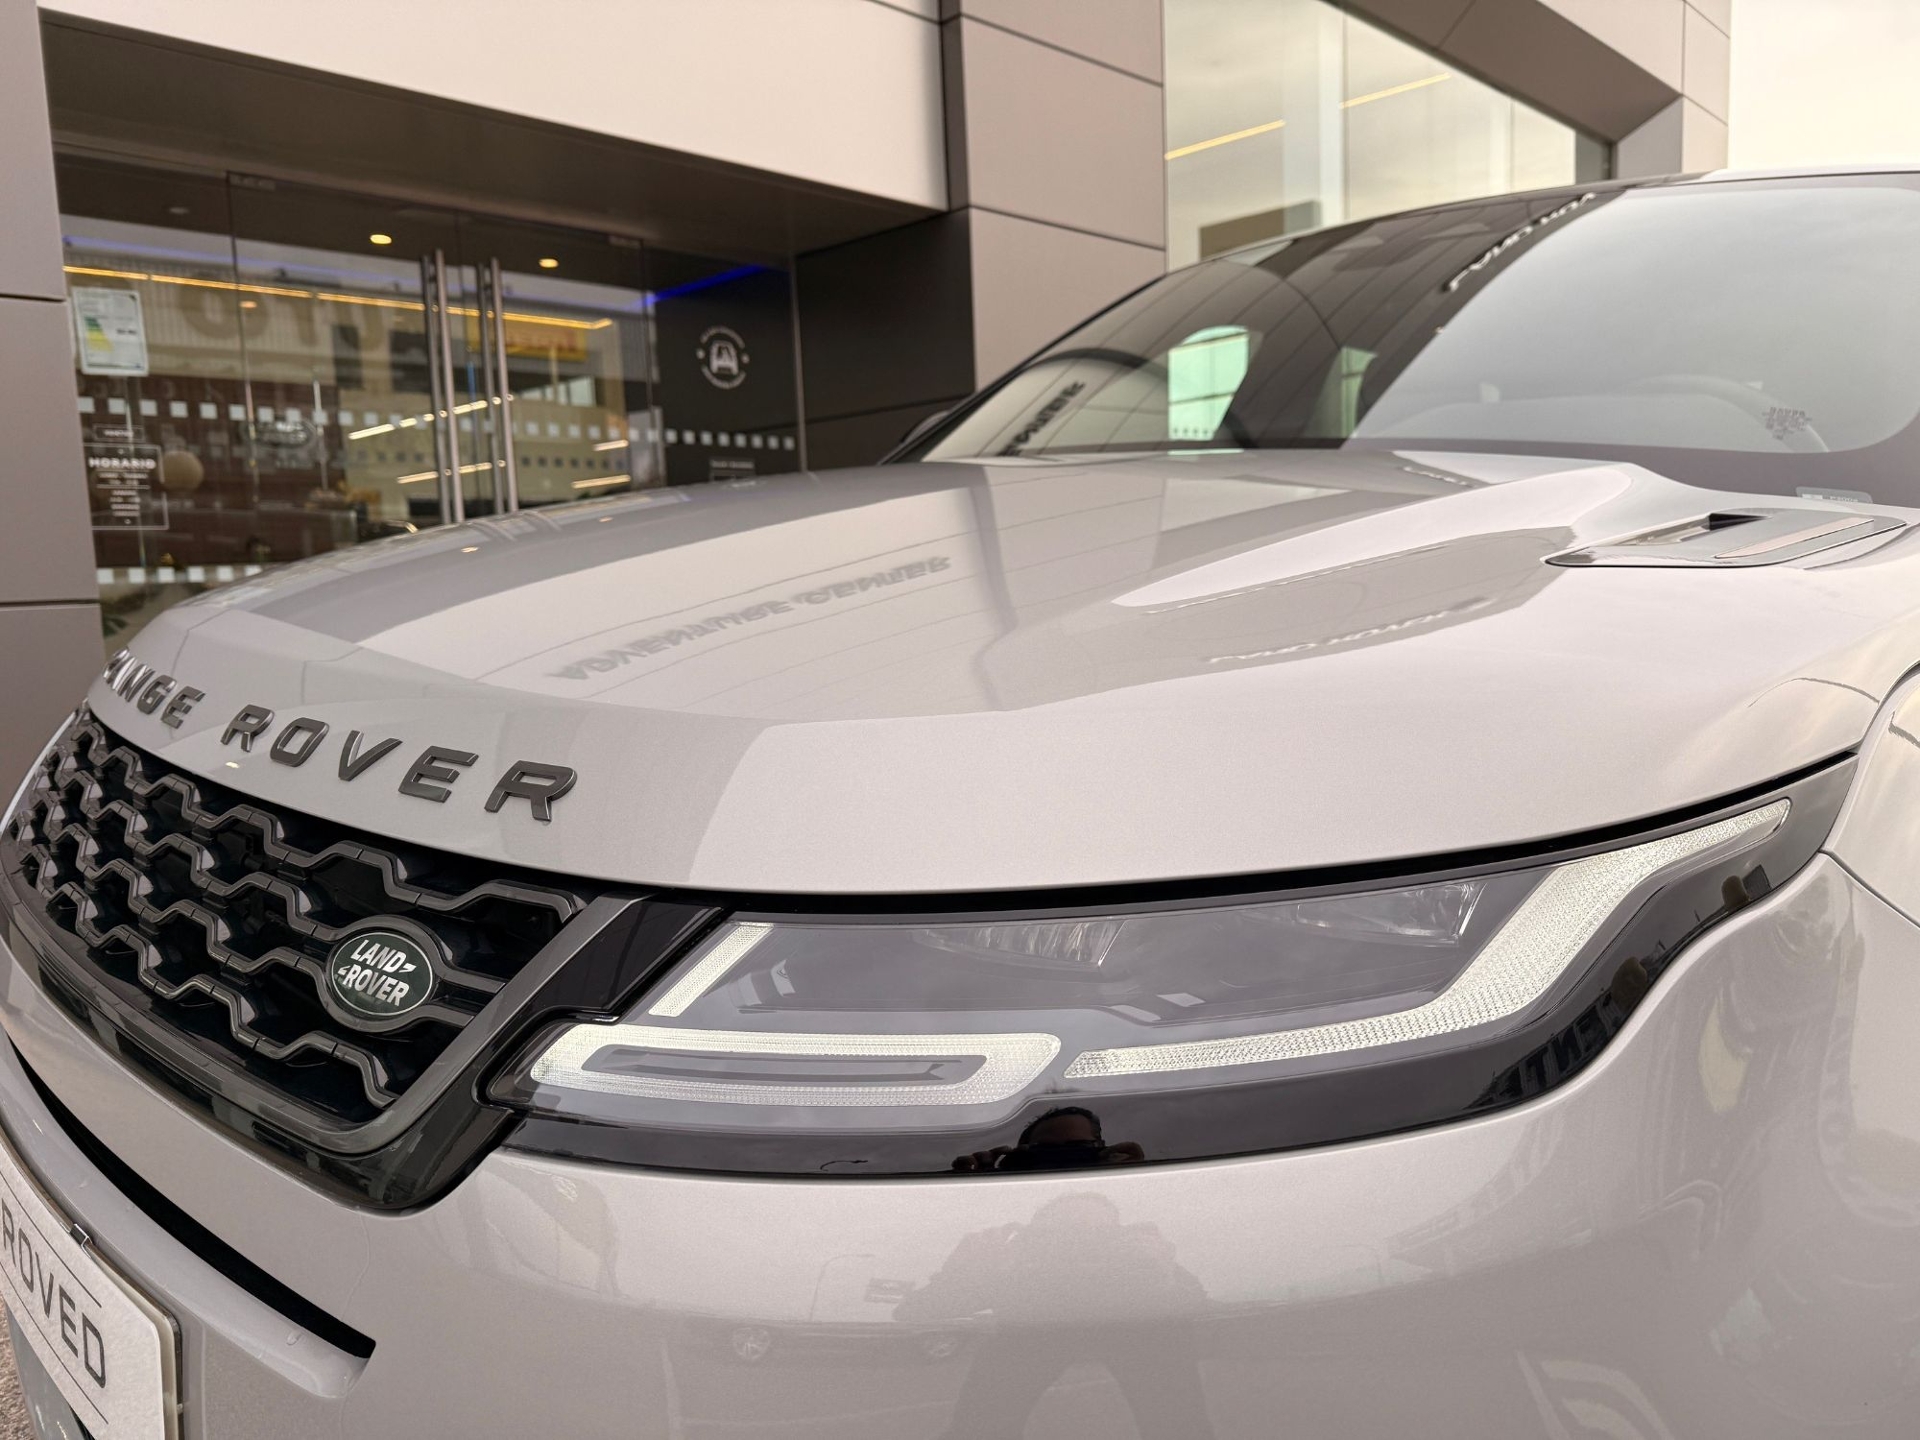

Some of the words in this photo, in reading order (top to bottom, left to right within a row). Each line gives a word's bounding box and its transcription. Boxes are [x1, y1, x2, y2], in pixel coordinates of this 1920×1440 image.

[220, 704, 578, 821] ROVER
[350, 939, 407, 973] LAND
[342, 964, 410, 1006] ROVER
